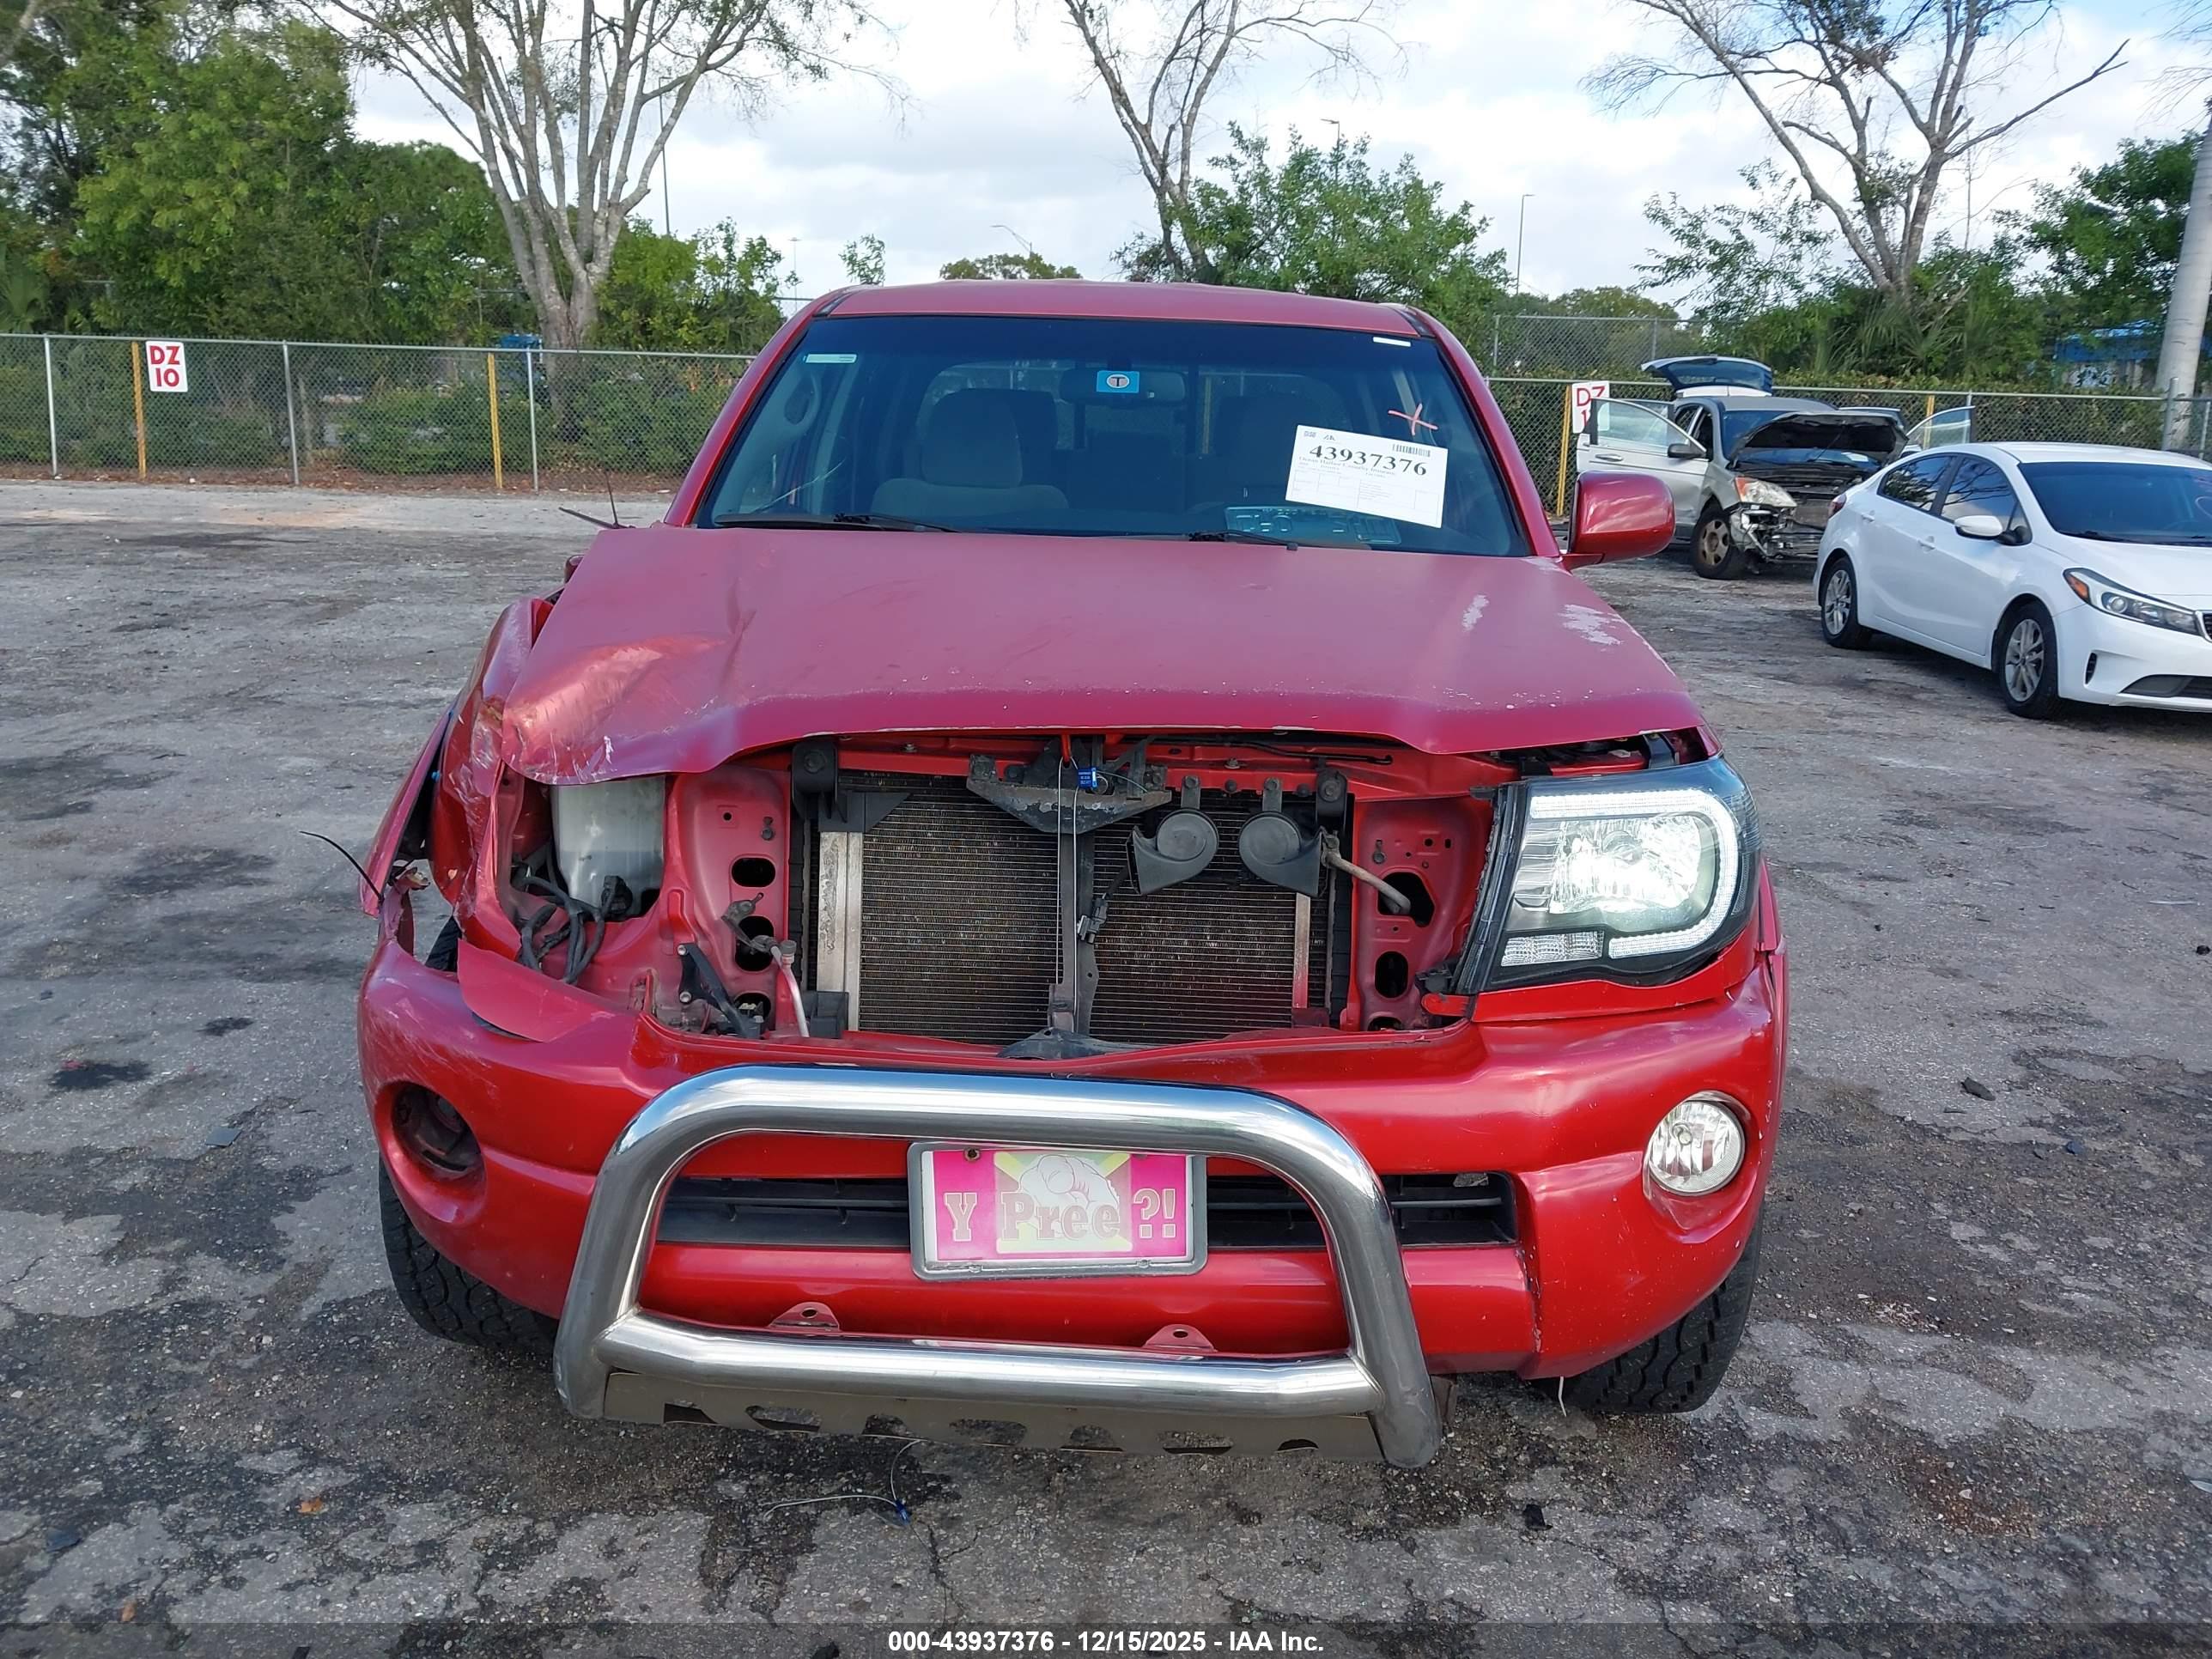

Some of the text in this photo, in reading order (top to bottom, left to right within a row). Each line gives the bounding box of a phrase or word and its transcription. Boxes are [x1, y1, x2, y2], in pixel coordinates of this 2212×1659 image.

[149, 345, 180, 365] DZ
[1310, 445, 1428, 476] 43937376
[945, 1192, 977, 1242] Y
